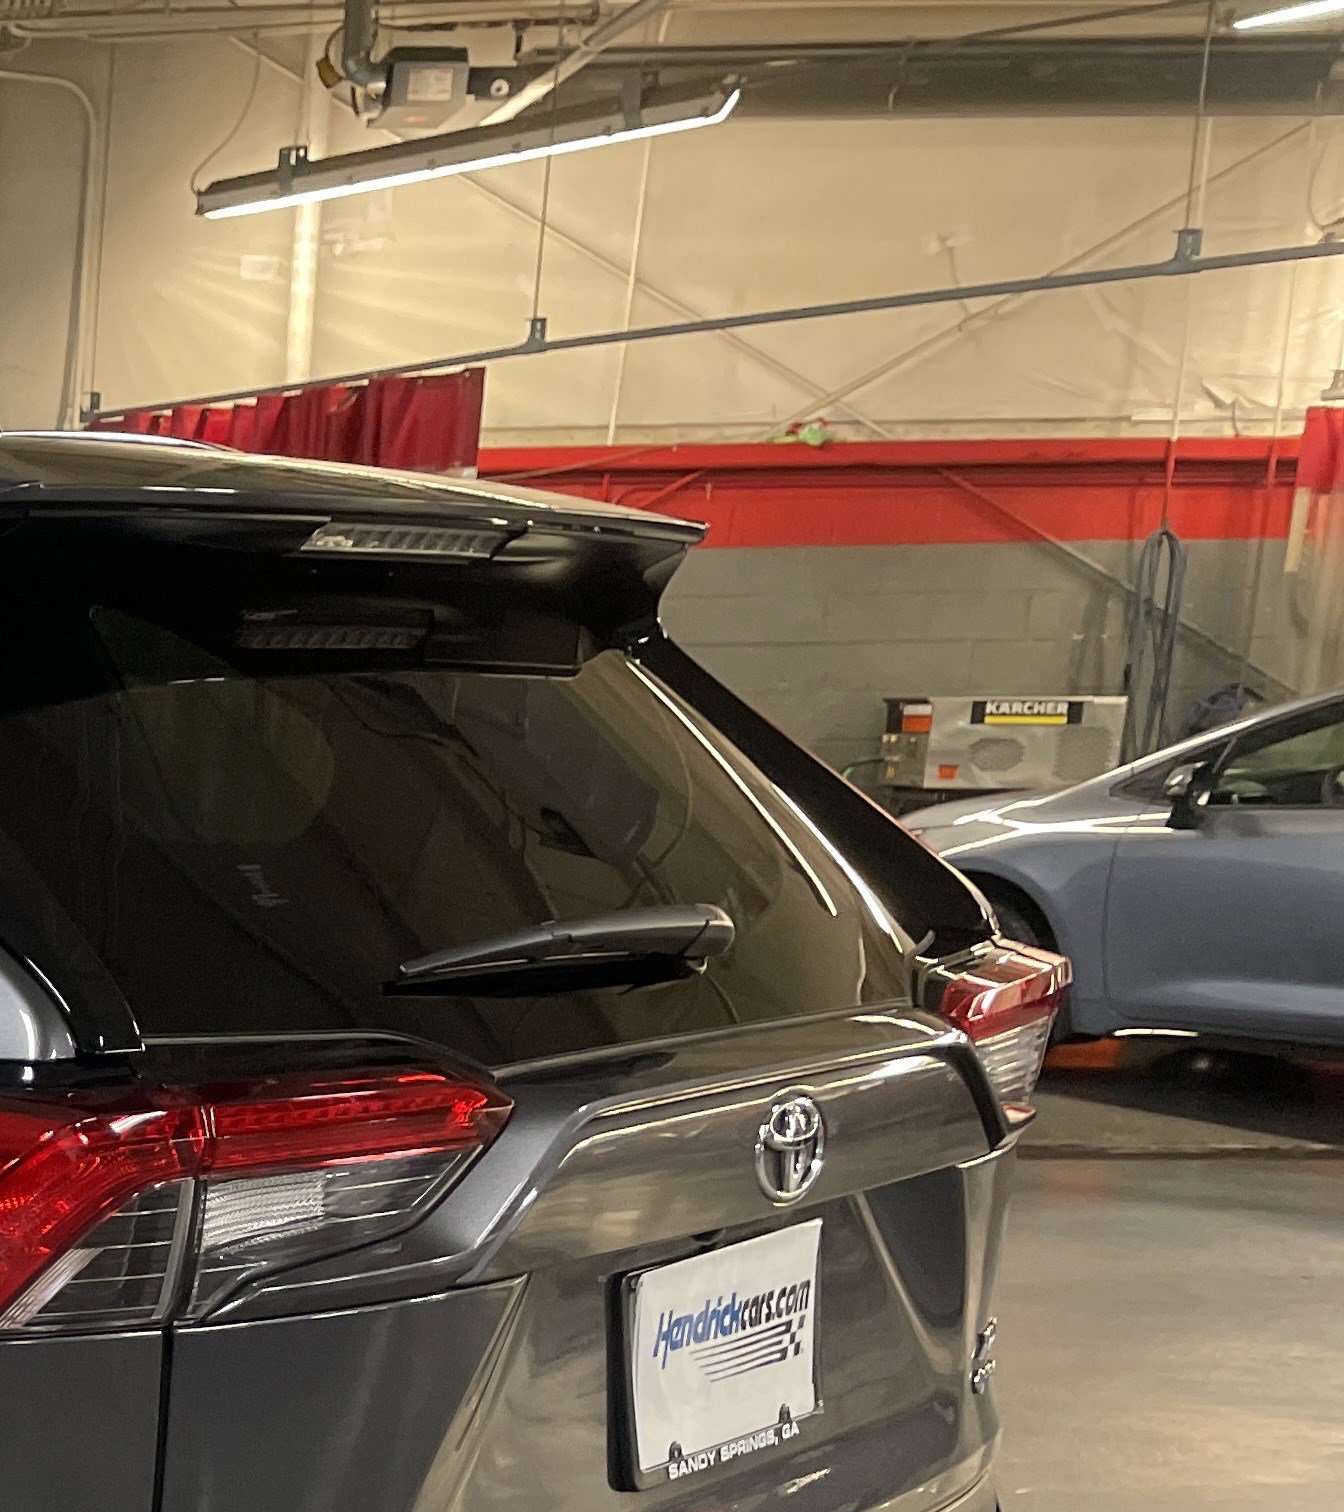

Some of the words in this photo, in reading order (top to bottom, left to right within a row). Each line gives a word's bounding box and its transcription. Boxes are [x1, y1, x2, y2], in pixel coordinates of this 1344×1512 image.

[653, 1279, 811, 1370] Hendrickcars.com
[668, 1450, 717, 1480] SANDY
[781, 1421, 800, 1440] GA
